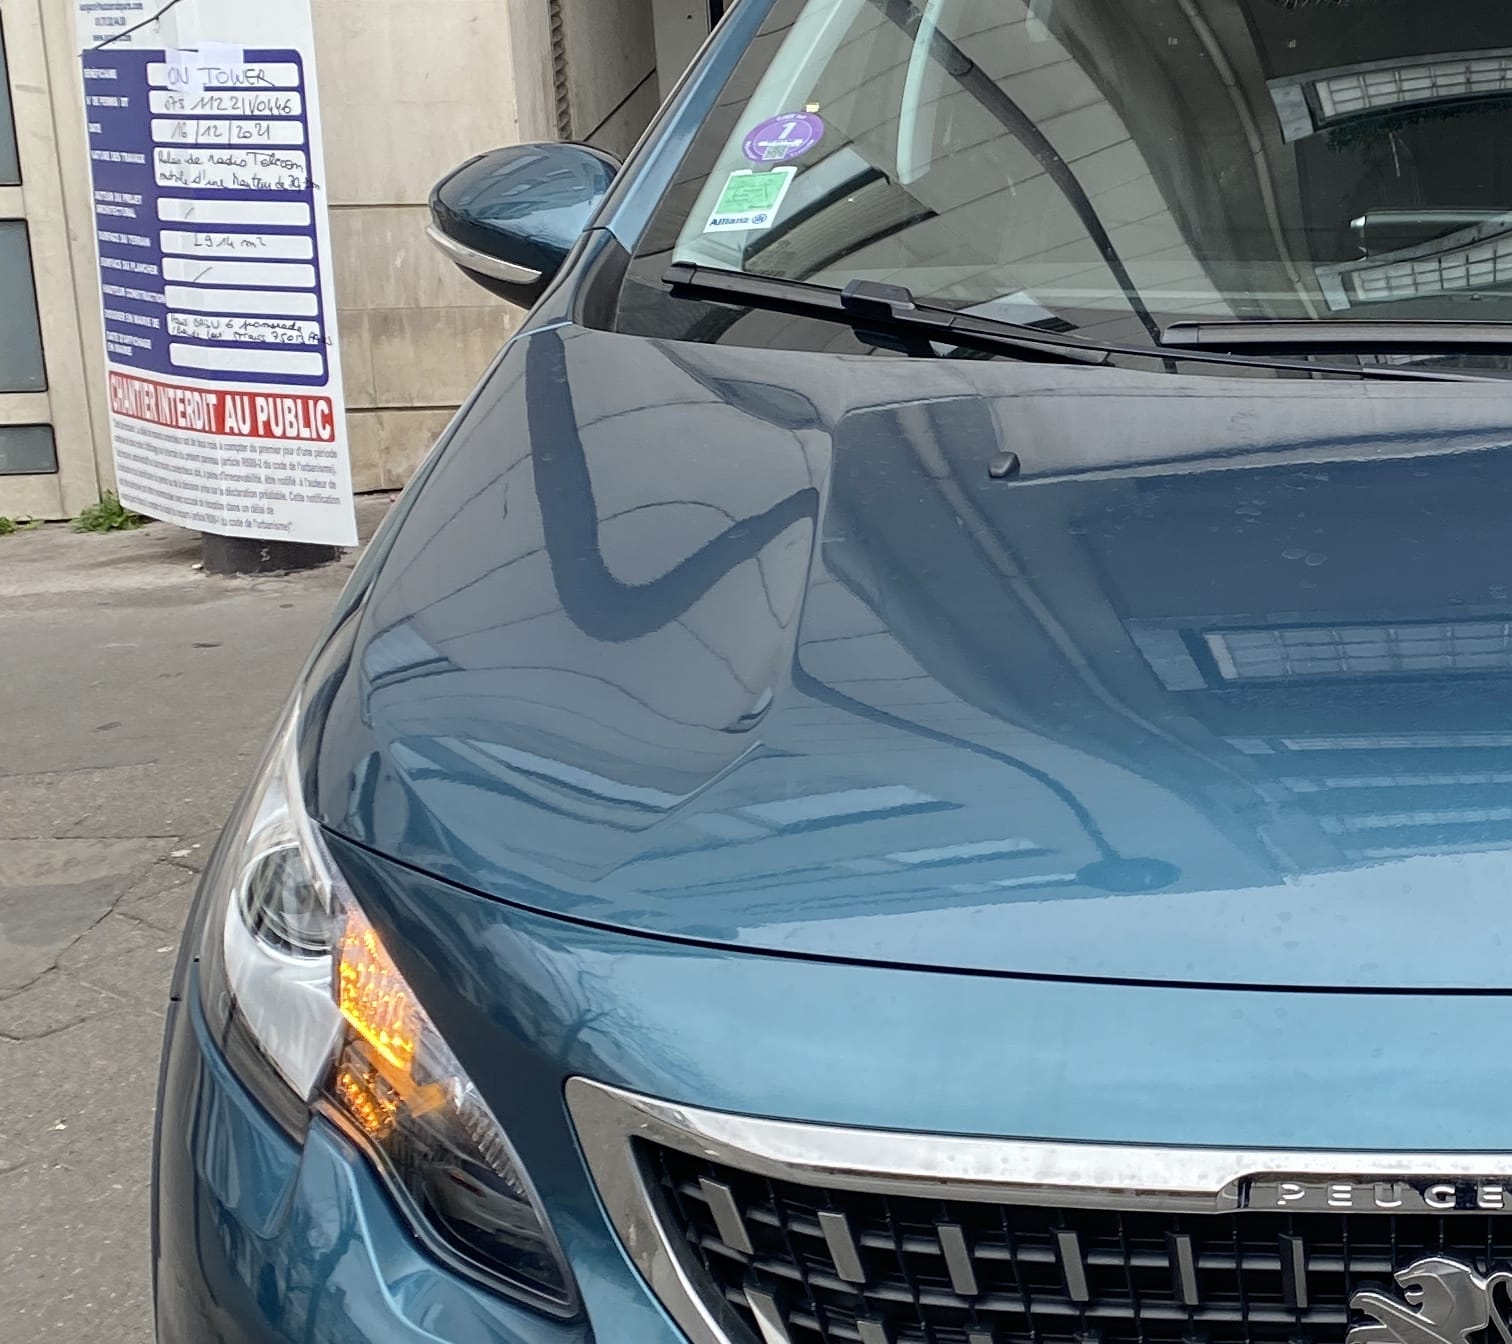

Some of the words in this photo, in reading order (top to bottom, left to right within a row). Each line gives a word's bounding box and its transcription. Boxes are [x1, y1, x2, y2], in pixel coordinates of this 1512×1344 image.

[778, 122, 797, 140] 1
[708, 217, 750, 227] Allianz
[110, 374, 158, 423] CHANTIER
[157, 385, 217, 433] INTERDIT
[224, 394, 251, 435] AU
[255, 396, 331, 441] PUBLIC
